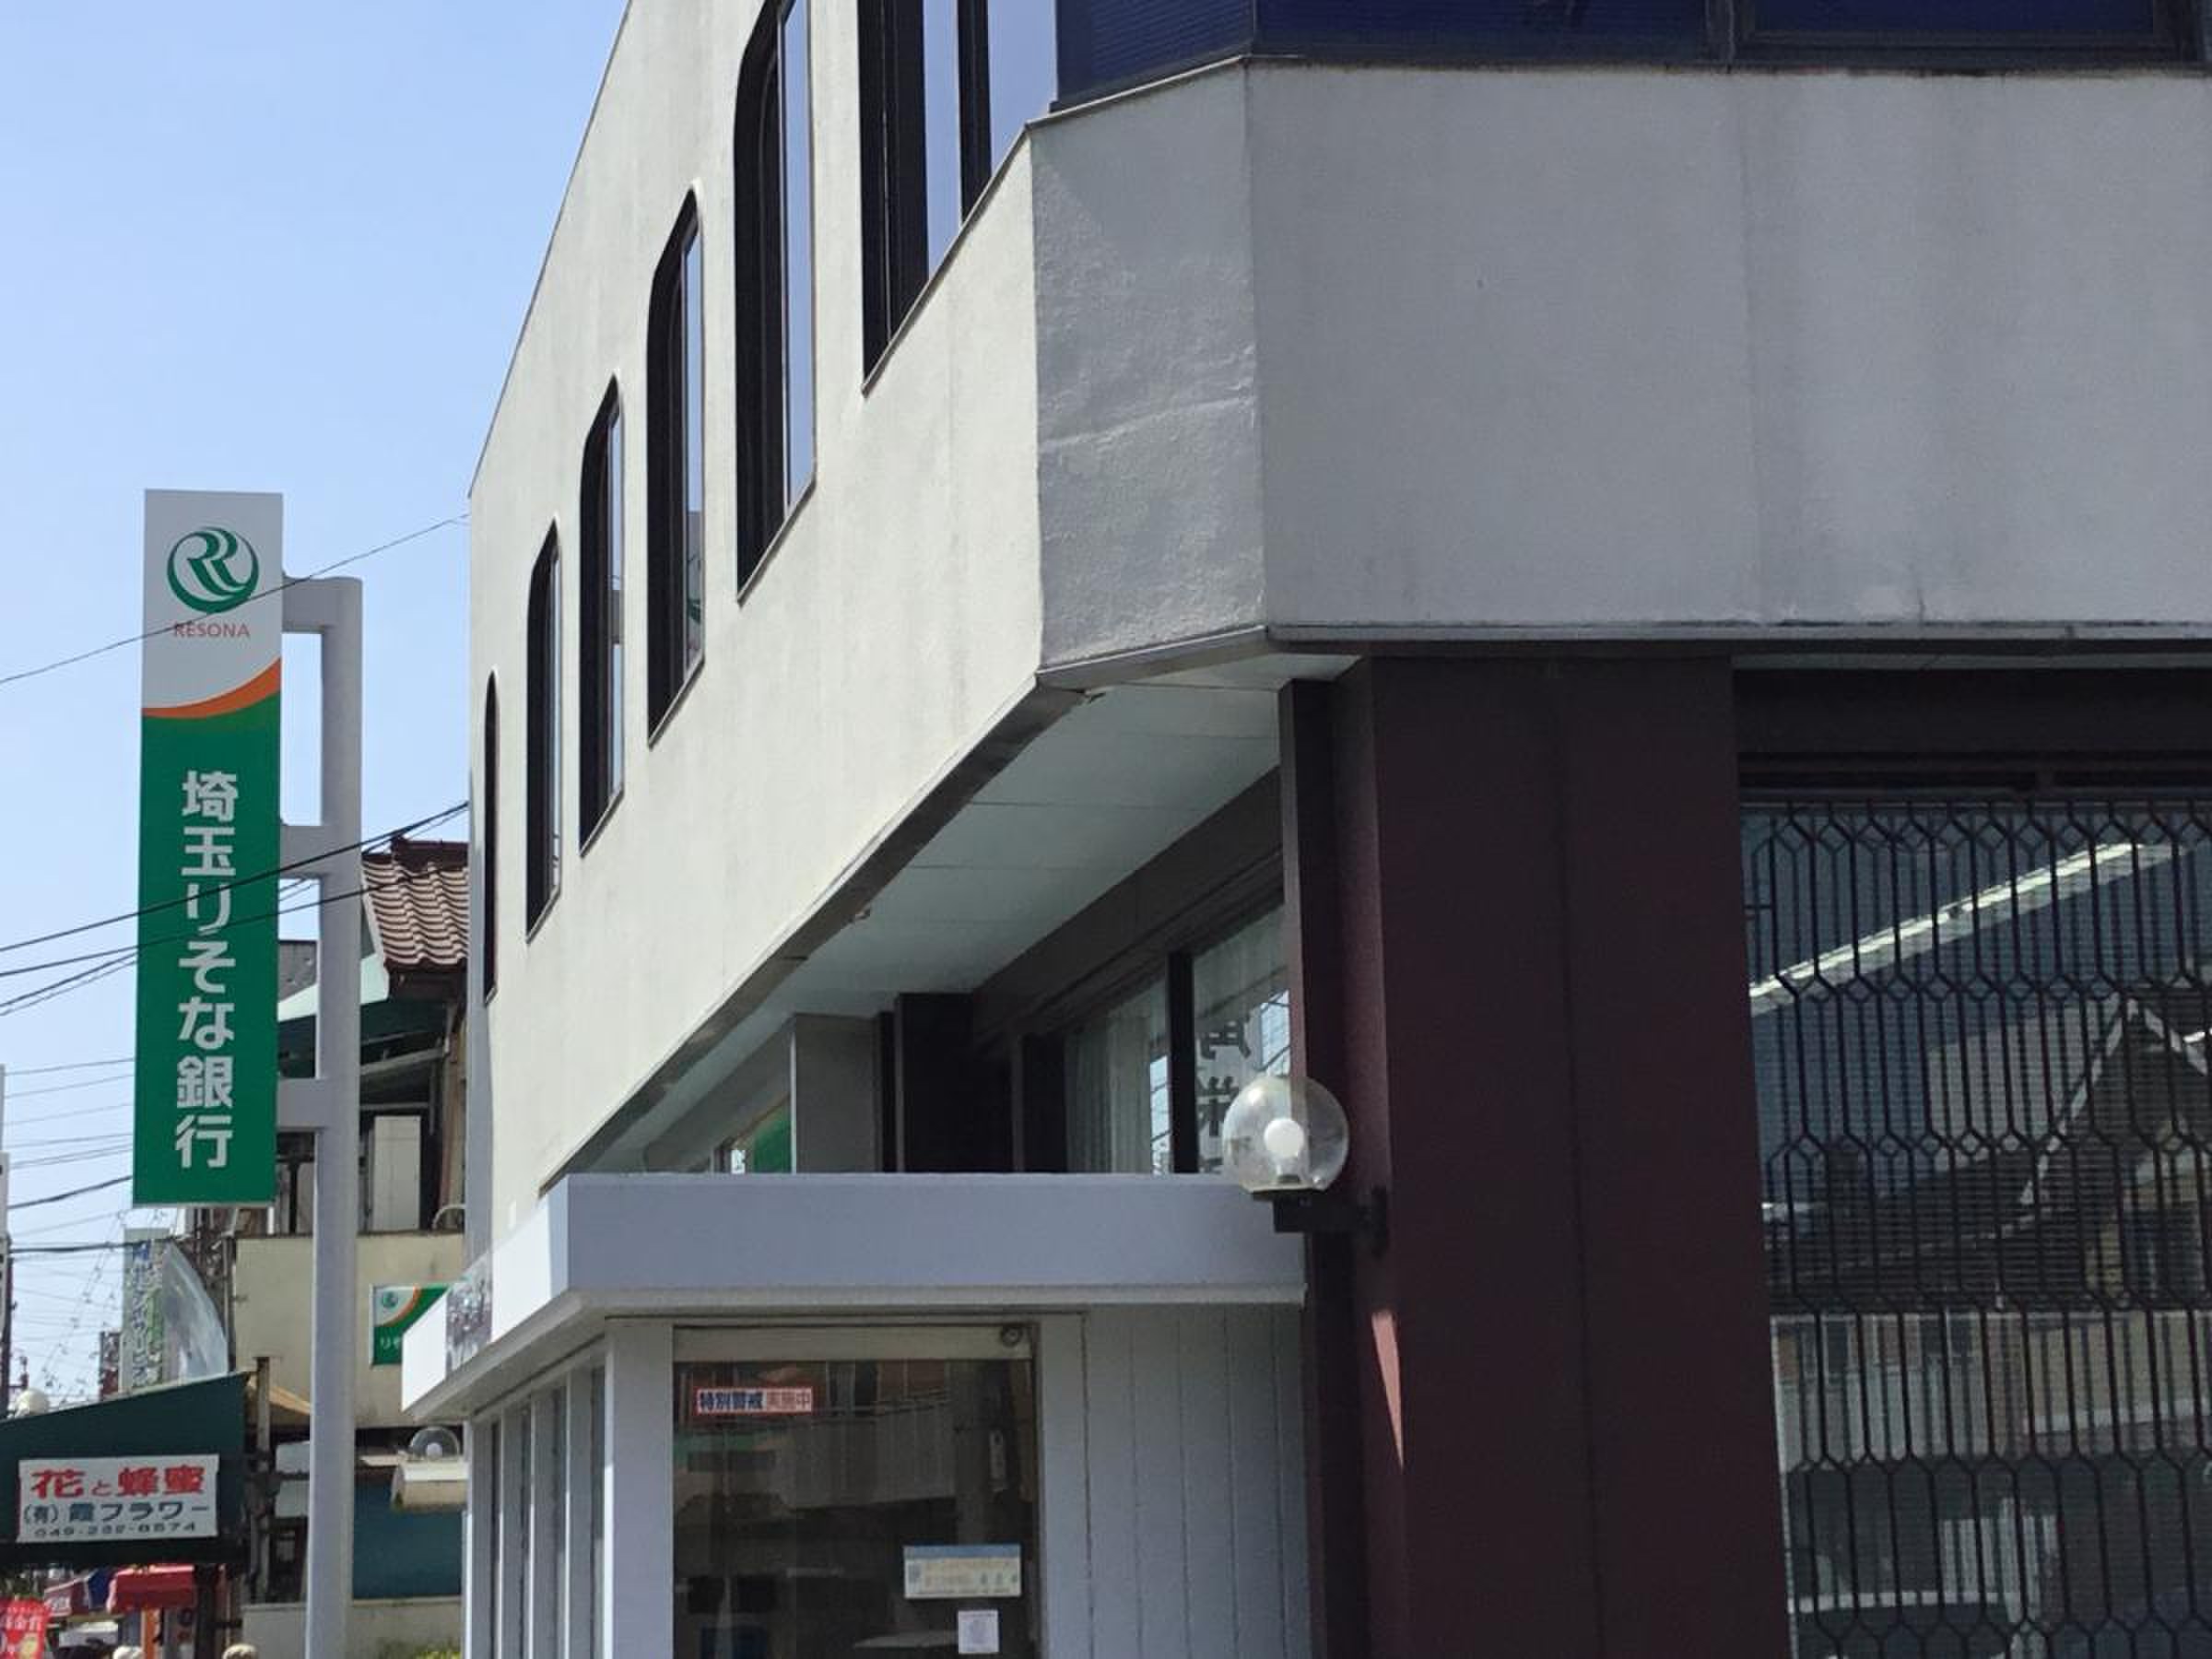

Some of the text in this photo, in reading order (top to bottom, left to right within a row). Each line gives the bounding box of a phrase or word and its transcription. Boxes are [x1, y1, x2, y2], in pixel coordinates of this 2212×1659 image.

[173, 622, 250, 638] RESONA
[175, 770, 238, 1169] 埼玉りそな銀行
[29, 1464, 206, 1500] 花と蜂蜜
